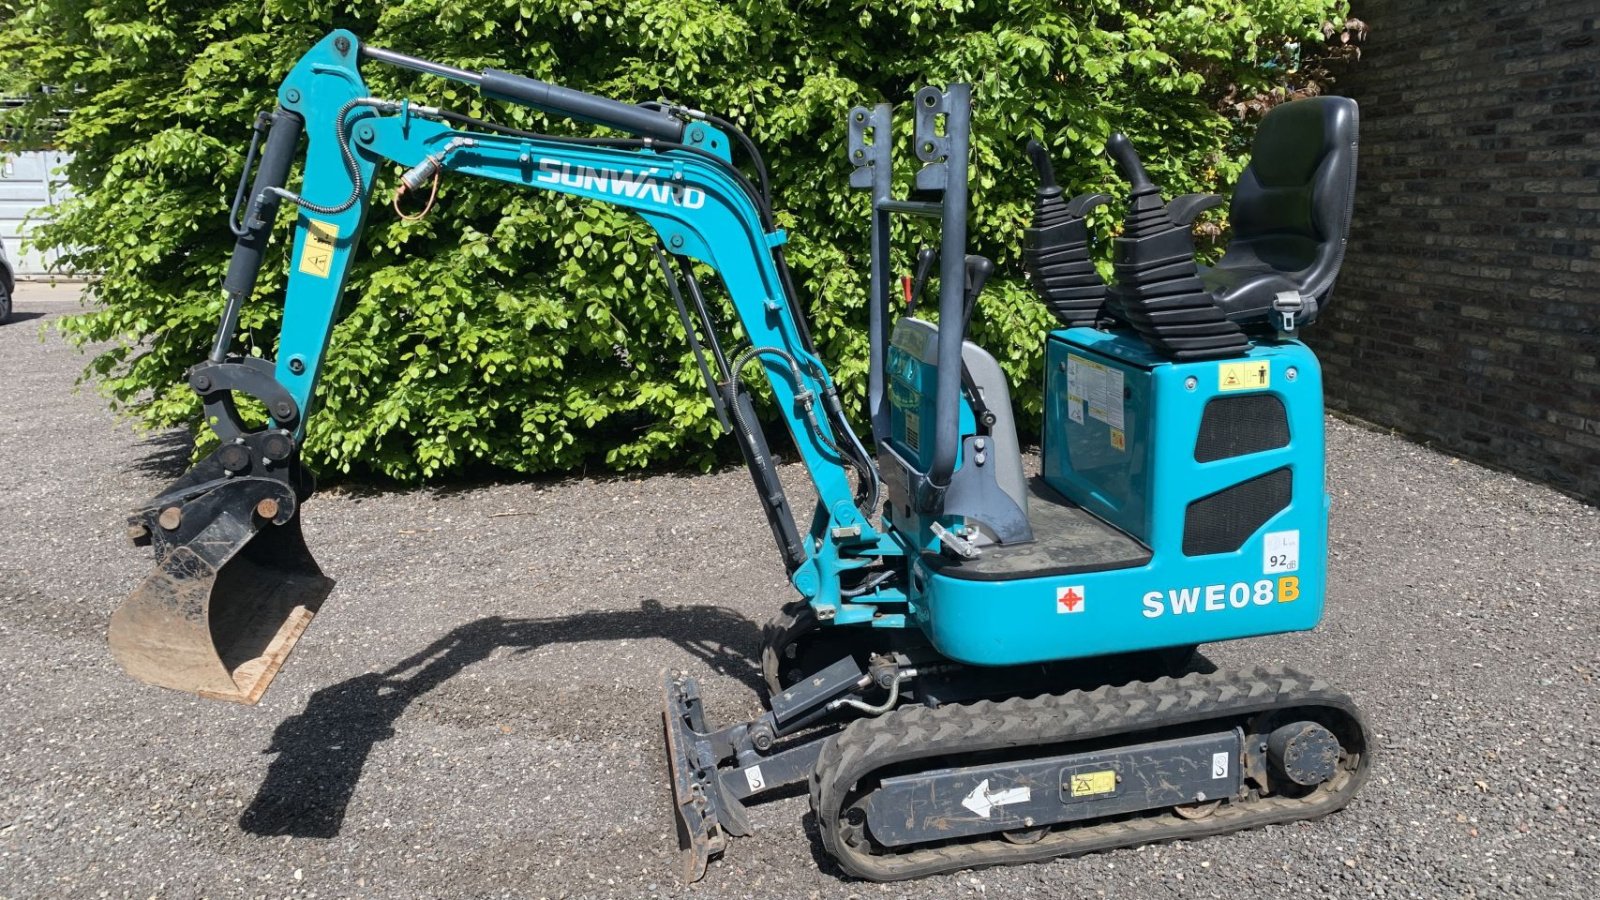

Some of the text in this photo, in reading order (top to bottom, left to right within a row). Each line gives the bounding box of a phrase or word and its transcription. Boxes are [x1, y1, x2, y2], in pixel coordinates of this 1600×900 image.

[537, 157, 706, 210] SUNWARD
[1270, 554, 1287, 567] 92
[1142, 576, 1300, 618] SWE08B
